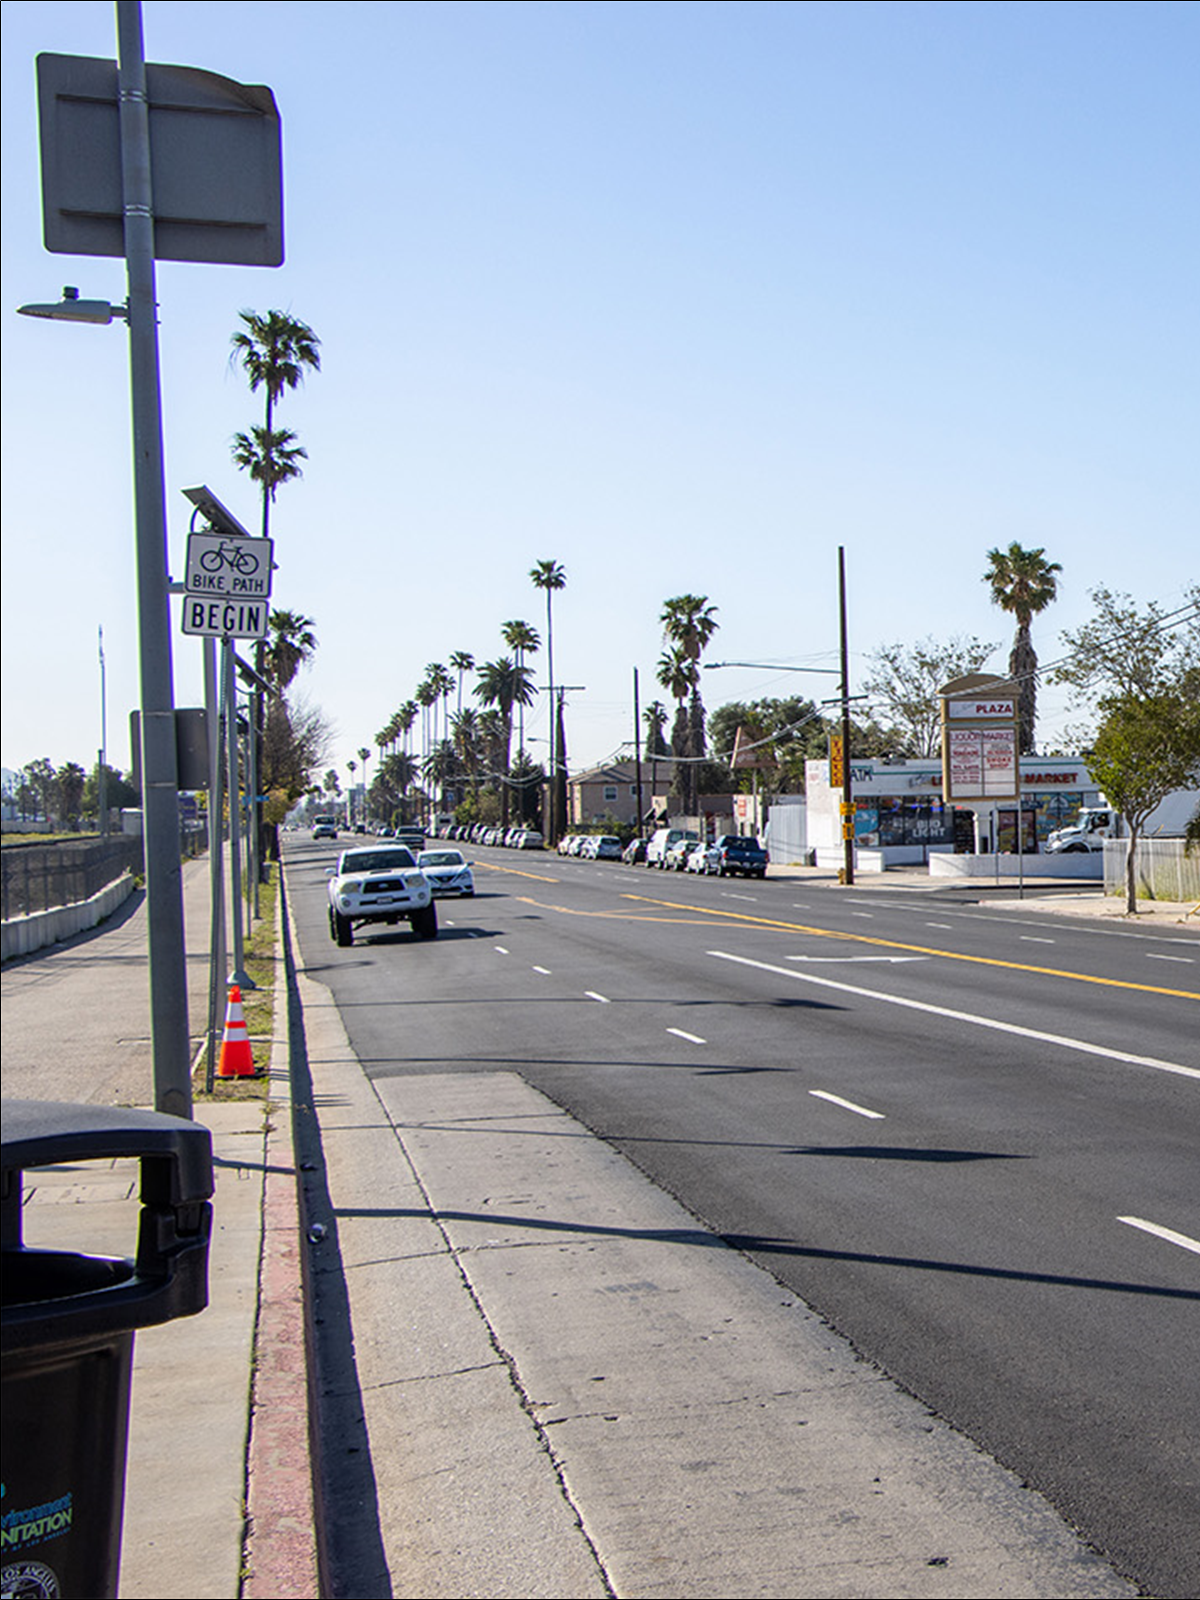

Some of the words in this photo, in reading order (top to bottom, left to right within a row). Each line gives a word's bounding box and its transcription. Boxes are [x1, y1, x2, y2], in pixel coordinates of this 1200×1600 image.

[193, 574, 225, 590] BIKE
[232, 578, 264, 592] PATH
[191, 603, 260, 632] BEGIN
[976, 704, 1012, 714] PLAZA
[851, 768, 874, 782] ATM
[1024, 772, 1078, 784] MARKET
[916, 820, 942, 829] BUD
[912, 828, 946, 837] LIGHT
